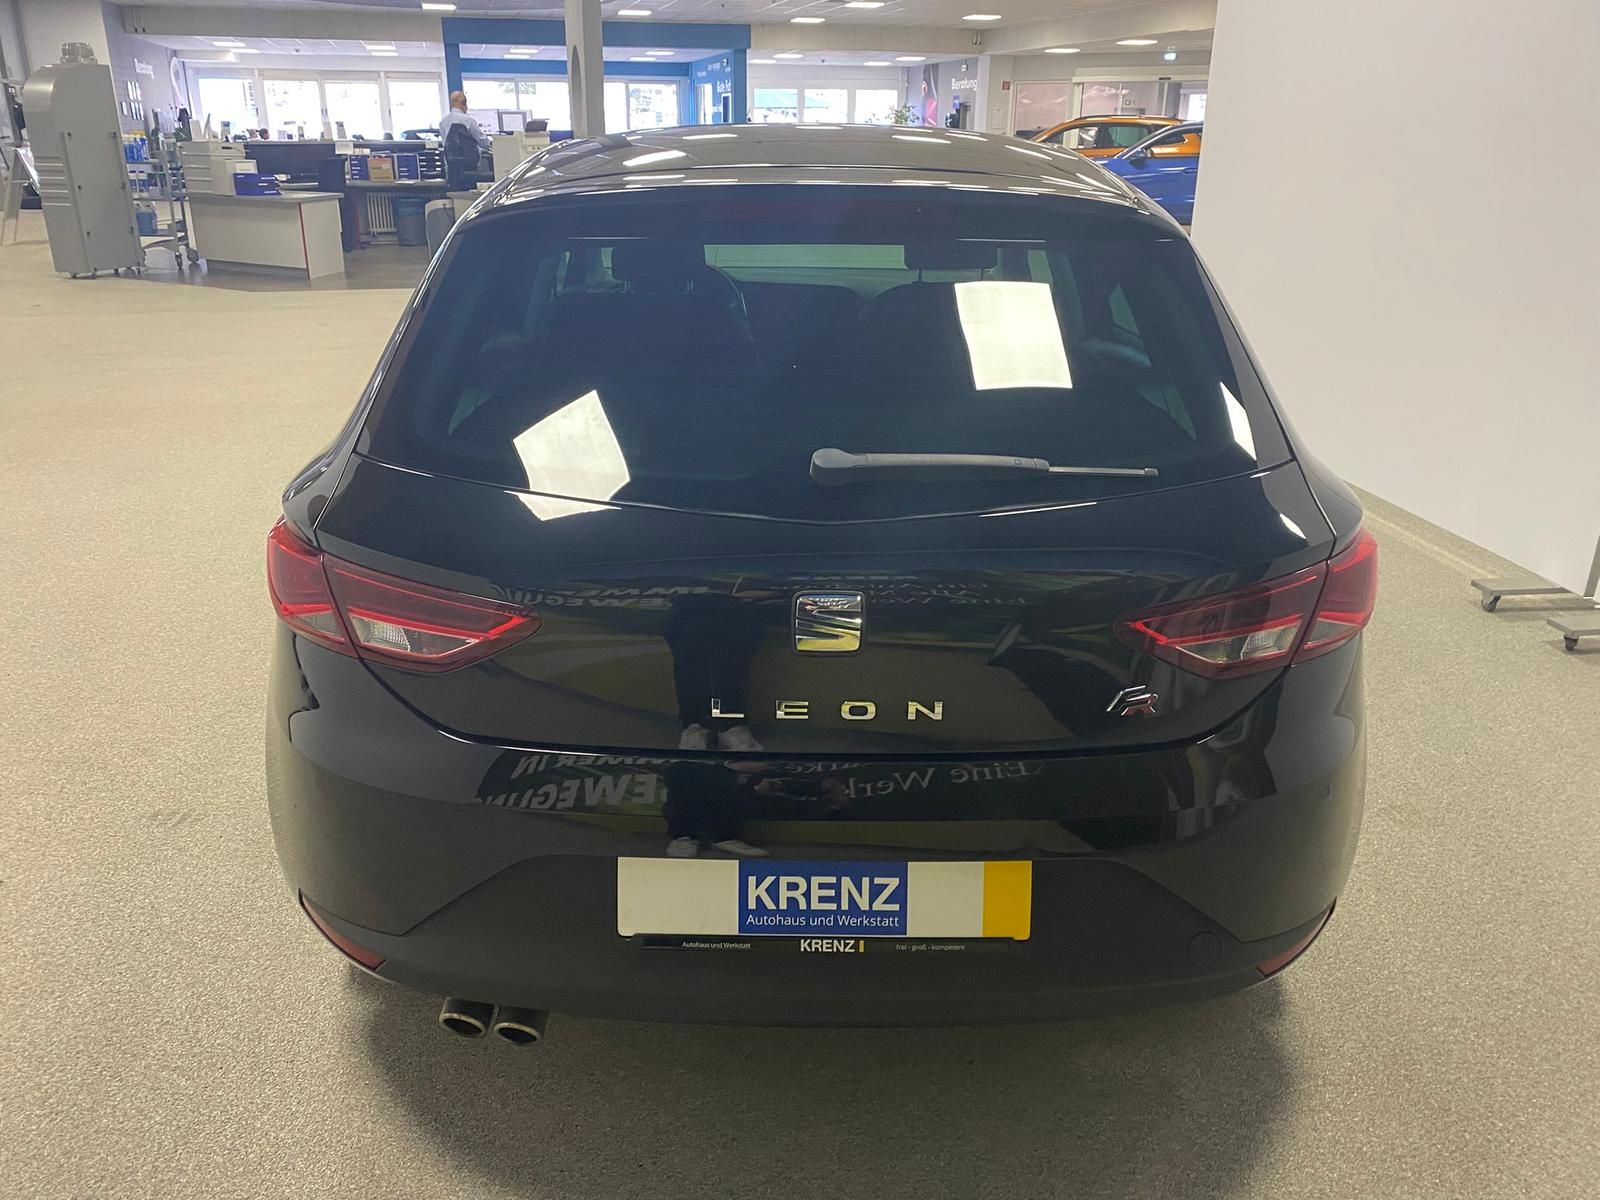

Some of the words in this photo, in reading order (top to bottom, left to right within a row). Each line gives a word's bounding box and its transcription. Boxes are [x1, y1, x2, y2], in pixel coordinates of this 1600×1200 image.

[711, 698, 943, 720] LEON
[1106, 685, 1159, 716] FR
[747, 875, 900, 912] KRENZ
[746, 914, 806, 926] Autohaus
[809, 914, 834, 926] und
[837, 915, 900, 927] Werkstatt
[682, 941, 710, 949] Autohaus
[723, 942, 752, 950] Werkstatt
[800, 939, 855, 953] KRENZ
